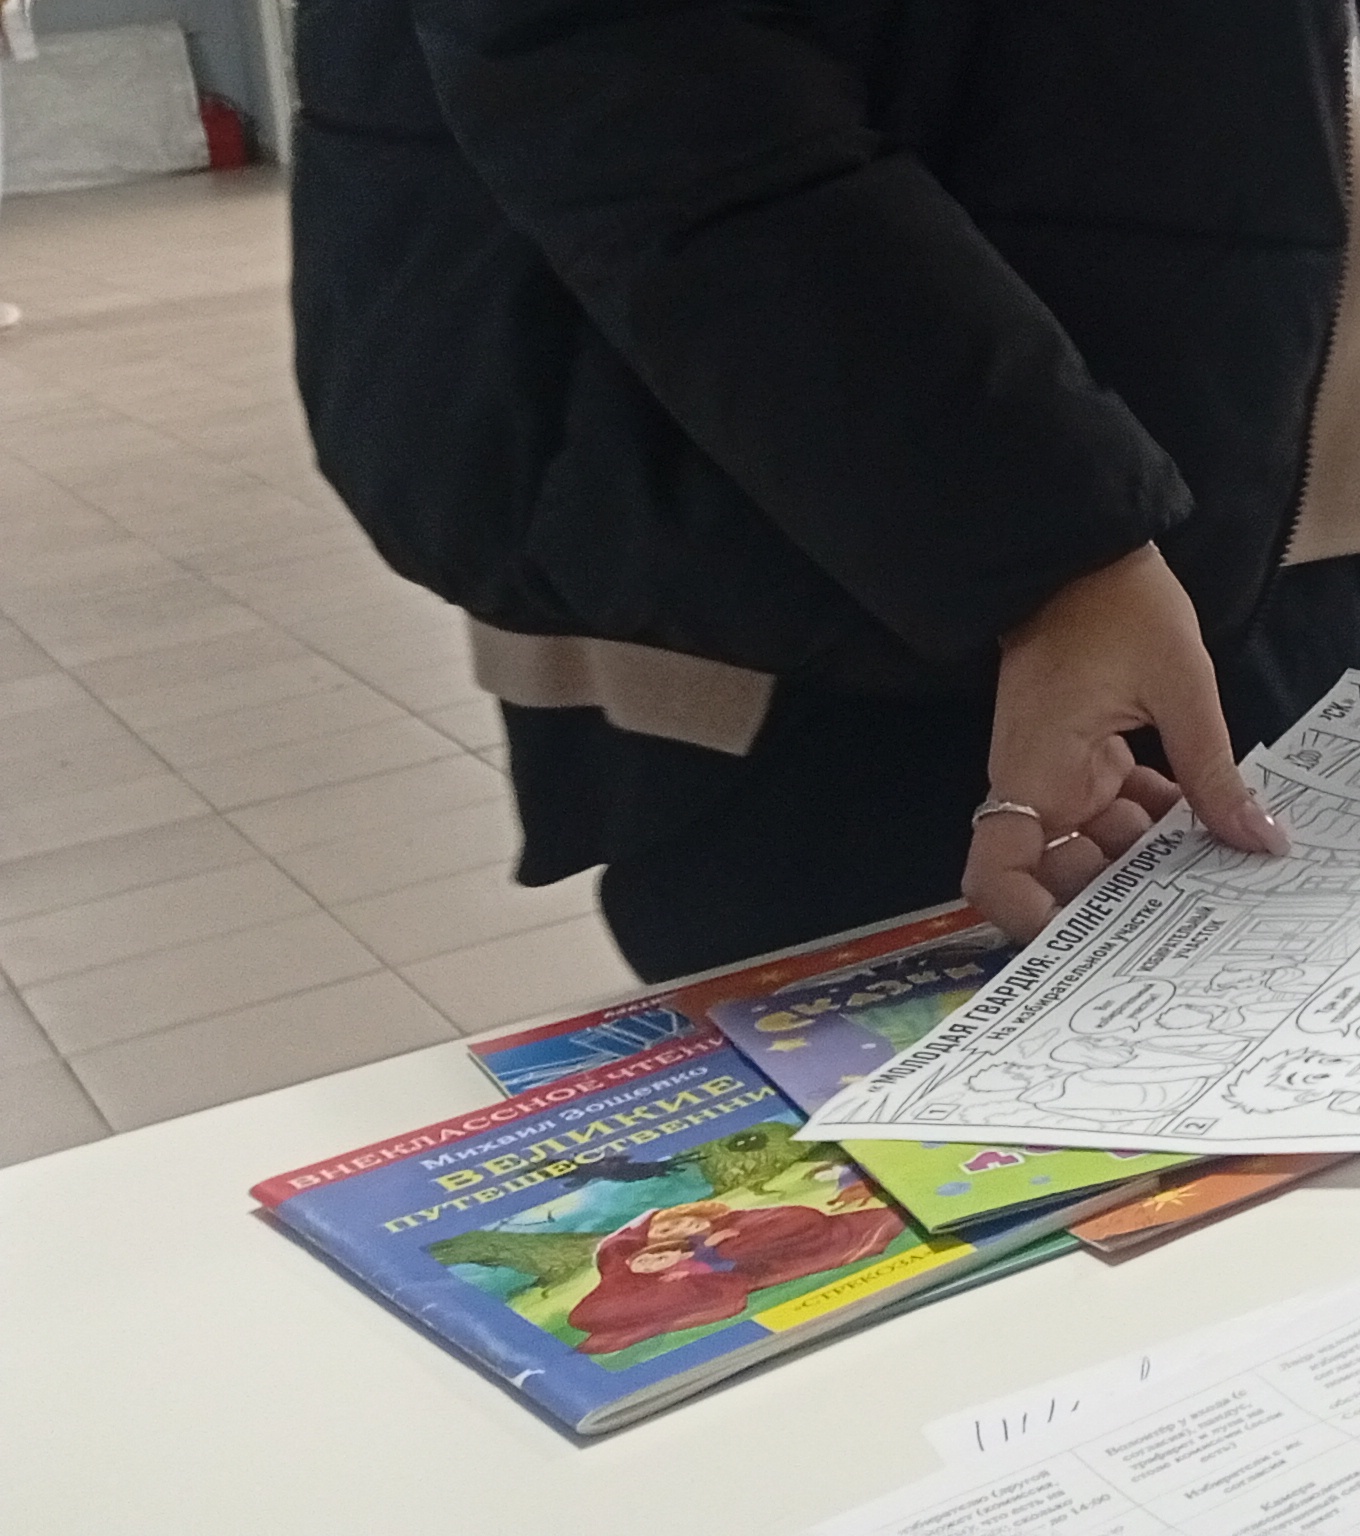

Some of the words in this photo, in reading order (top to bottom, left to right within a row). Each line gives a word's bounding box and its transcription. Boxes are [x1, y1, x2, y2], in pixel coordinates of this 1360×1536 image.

[869, 1021, 972, 1094] «МОЛОДАЯ
[964, 942, 1062, 1025] ГВАРДИЯ:
[1046, 826, 1187, 954] СОЛНЕЧНОГОРСК»
[1014, 939, 1116, 1027] избирательном
[1111, 895, 1165, 946] участке
[288, 1077, 605, 1192] ВНЕКЛАССНОЕ
[606, 1035, 724, 1080] ЧТЕНИ
[382, 1085, 777, 1235] ПУТЕШЕСТВЕННИ
[420, 1119, 557, 1172] Михаил
[432, 1075, 747, 1194] ВЕЛИКИЕ
